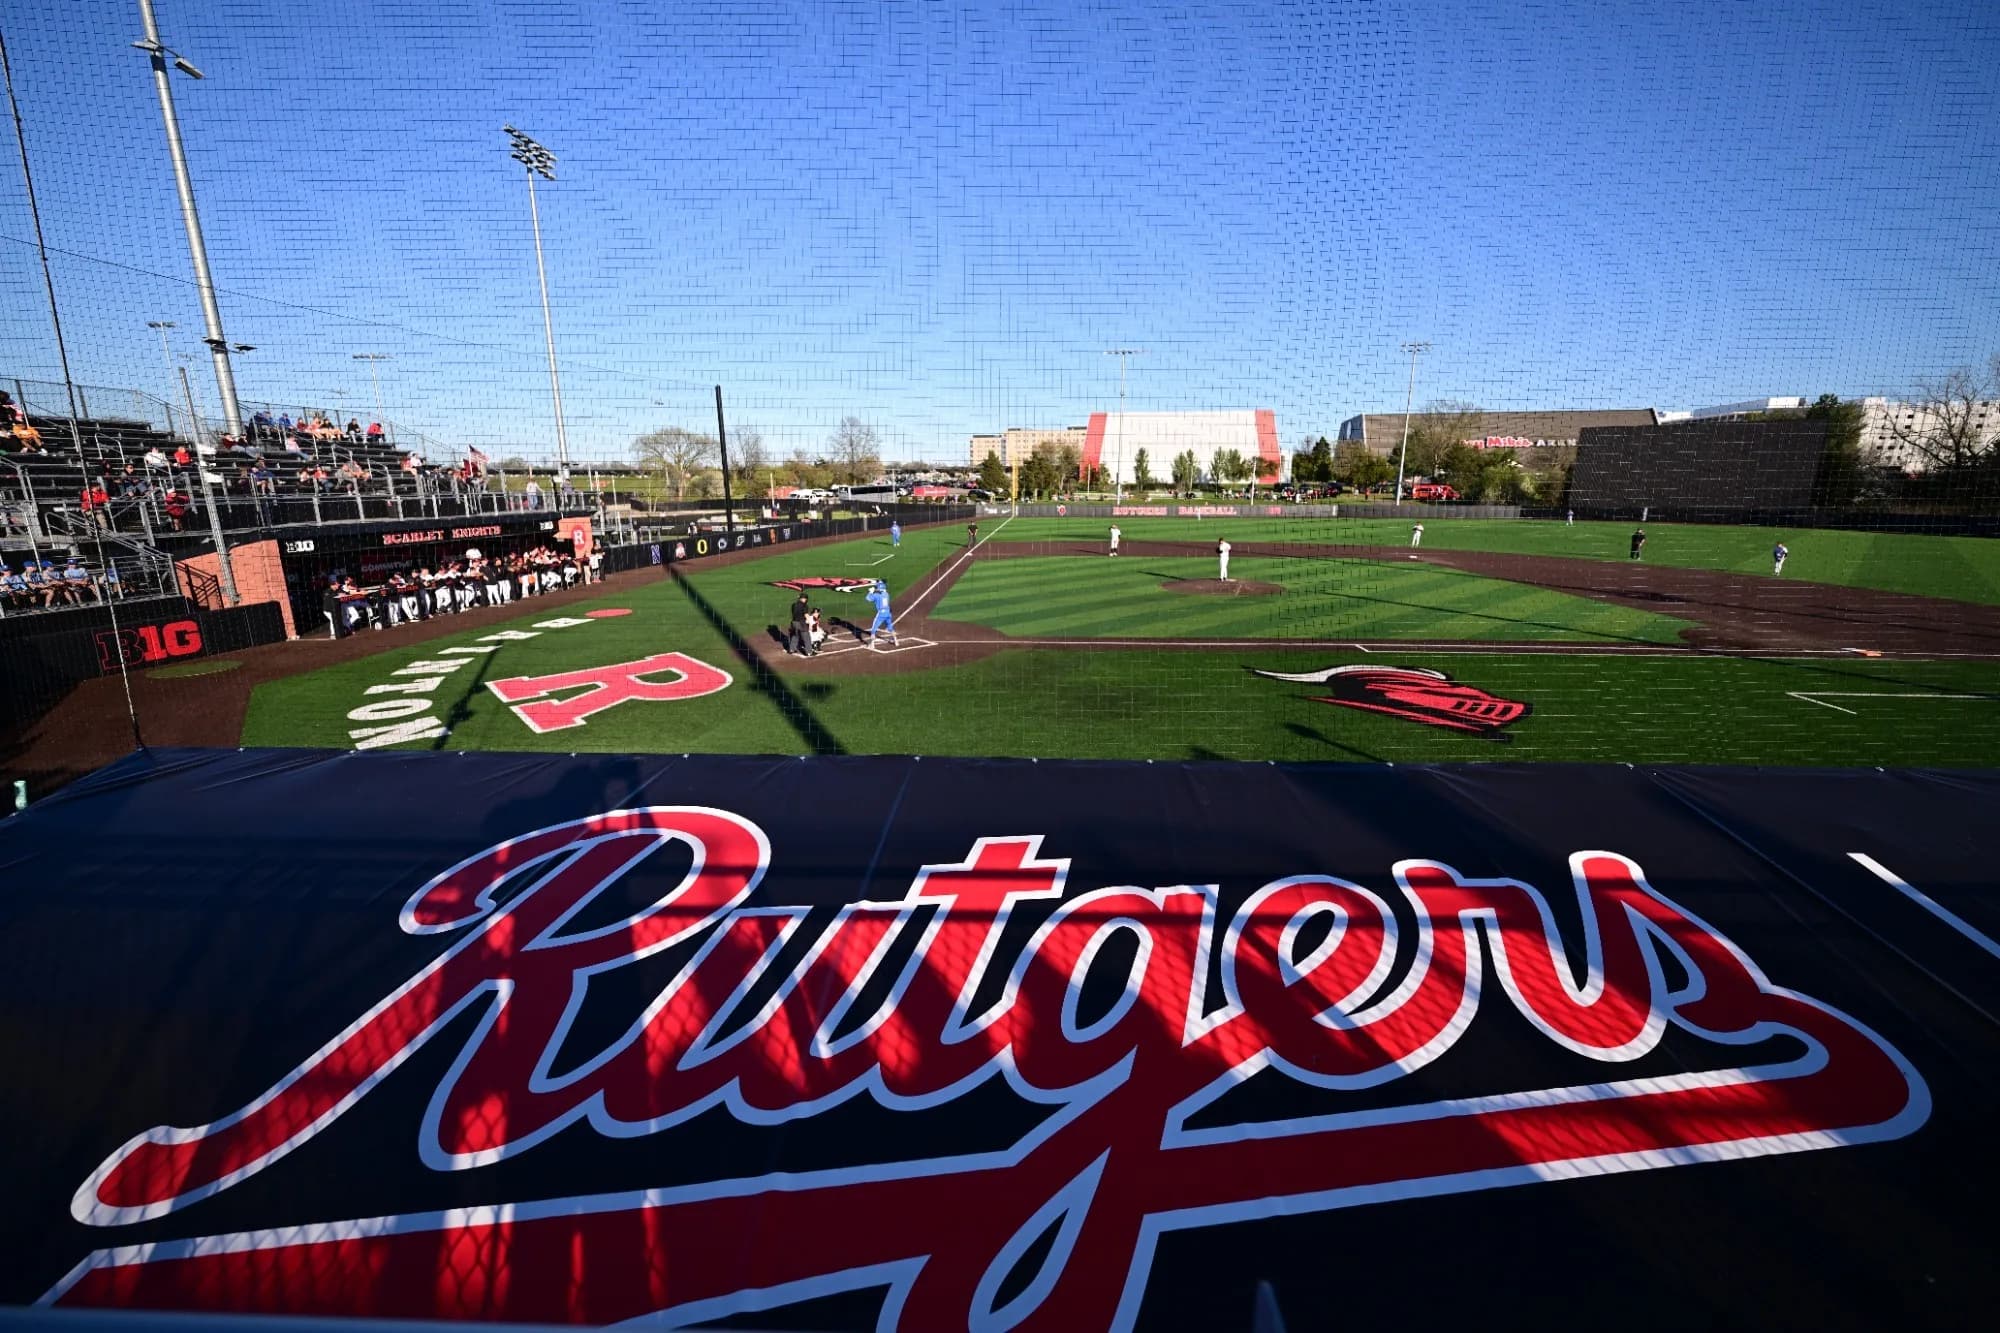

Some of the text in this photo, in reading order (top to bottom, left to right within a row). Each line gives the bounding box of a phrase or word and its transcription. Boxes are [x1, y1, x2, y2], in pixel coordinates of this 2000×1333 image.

[1536, 438, 1577, 447] AREN
[383, 525, 501, 545] SCARLET KNIGHTS
[484, 651, 734, 734] R
[50, 804, 1932, 1333] Rutgers
